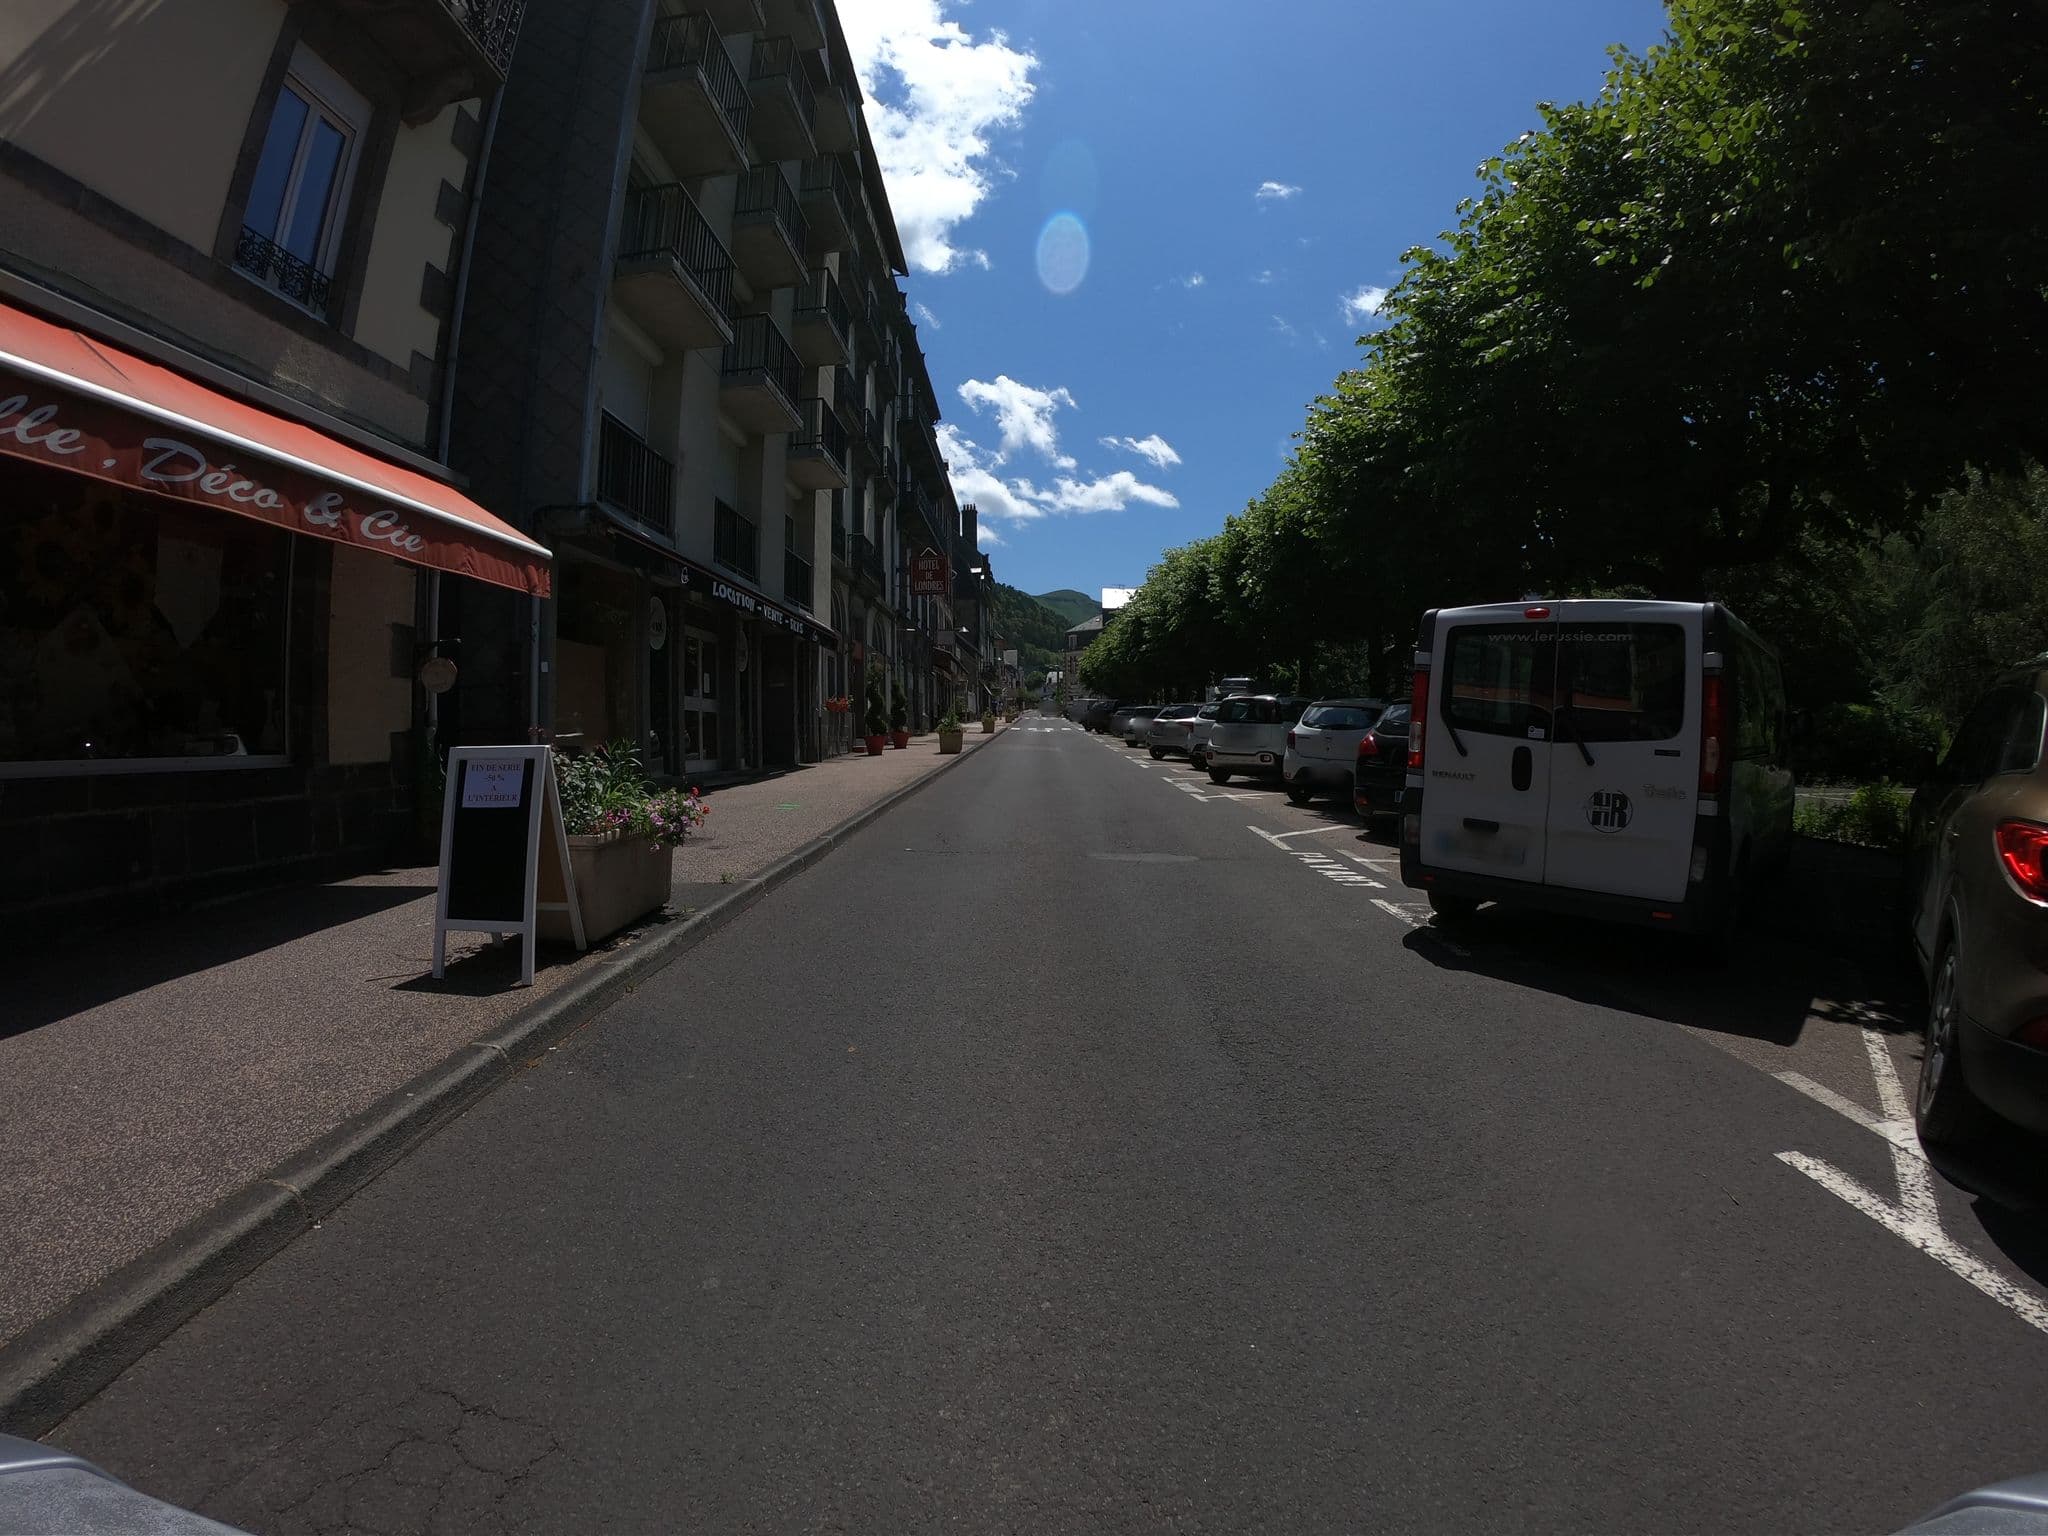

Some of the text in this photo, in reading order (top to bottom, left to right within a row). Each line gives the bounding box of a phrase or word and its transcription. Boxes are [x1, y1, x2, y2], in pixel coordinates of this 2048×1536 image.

[139, 437, 284, 510] Déco
[303, 492, 345, 528] &
[359, 510, 427, 553] Cie
[918, 559, 941, 570] HOTEL
[925, 571, 935, 580] DE
[914, 580, 946, 592] LONDRES
[712, 581, 755, 613] LOCATION
[763, 604, 784, 625] VENTE
[1487, 629, 1632, 641] www.lerussie.com
[471, 764, 485, 772] FIN
[1432, 769, 1477, 781] RENAULT
